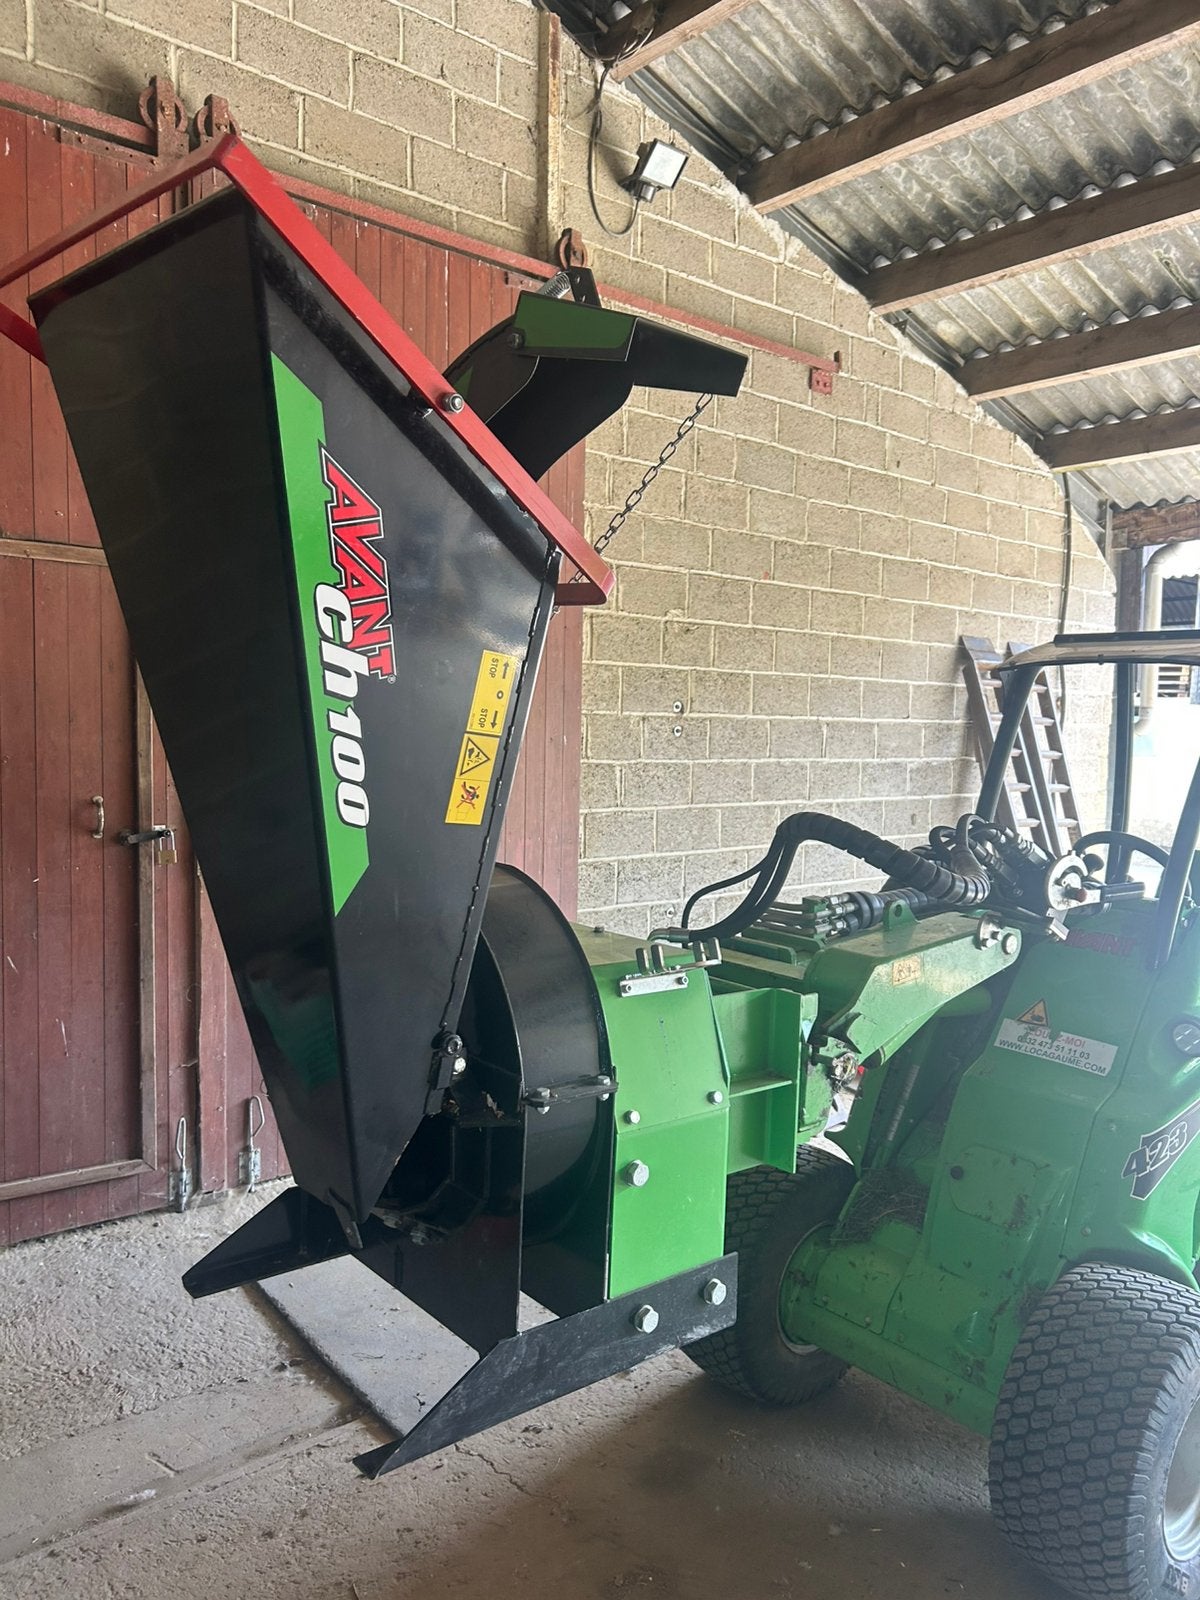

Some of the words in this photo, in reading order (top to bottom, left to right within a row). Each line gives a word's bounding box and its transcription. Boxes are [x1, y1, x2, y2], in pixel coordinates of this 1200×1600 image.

[322, 449, 397, 679] AVANT
[490, 657, 499, 679] STOP
[479, 708, 488, 728] STOP
[1000, 1039, 1107, 1074] WWW.LOCAGAUME.COM
[1055, 1043, 1065, 1053] 51
[1079, 1050, 1090, 1060] 03
[1121, 1121, 1188, 1179] 423
